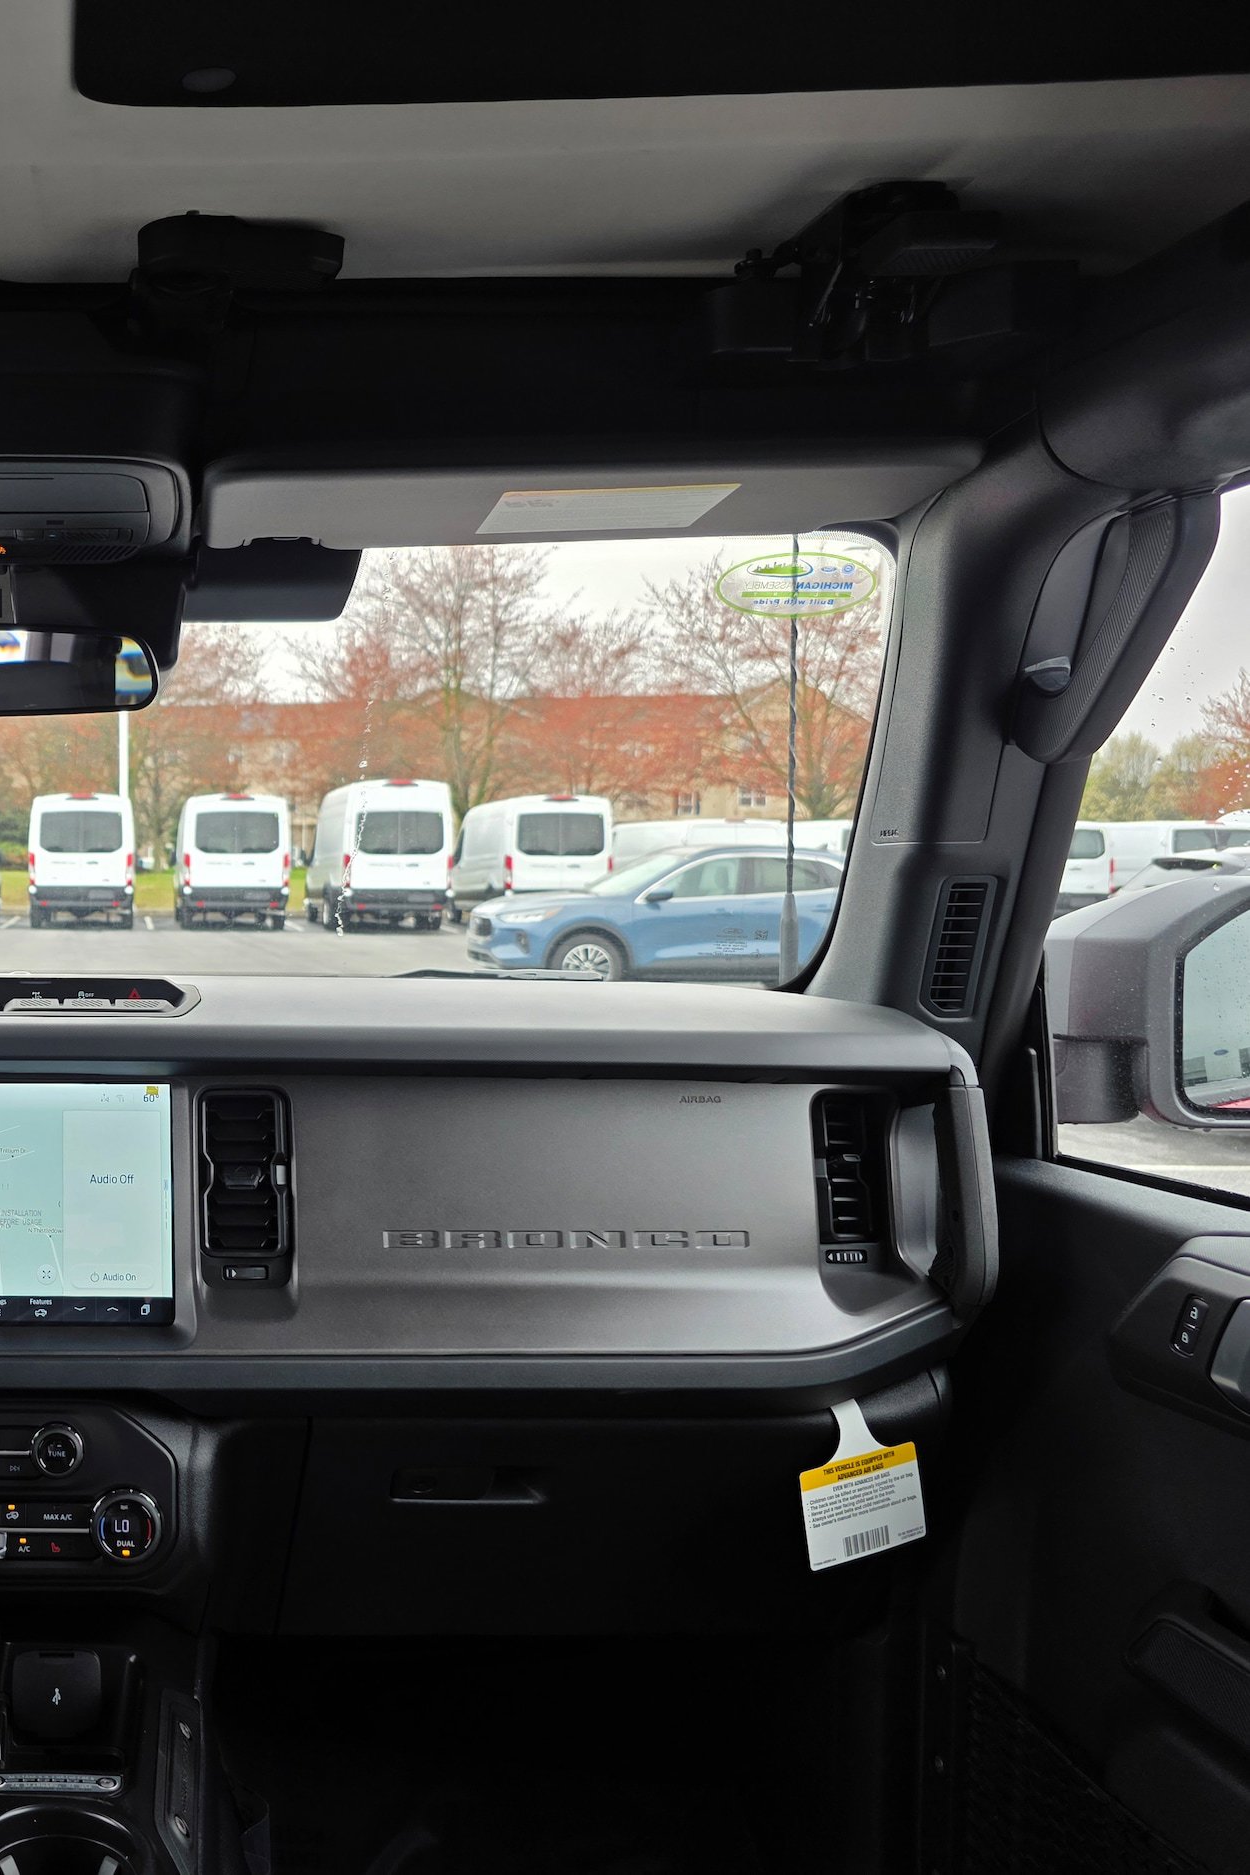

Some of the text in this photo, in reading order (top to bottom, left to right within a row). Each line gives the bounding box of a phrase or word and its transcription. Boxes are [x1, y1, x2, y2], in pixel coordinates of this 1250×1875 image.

[679, 1095, 722, 1104] AIRBAG
[89, 1174, 135, 1185] Audio Off
[0, 1209, 42, 1217] INSTALLATION
[382, 1229, 750, 1249] BRONCO
[103, 1273, 137, 1282] Audio On
[836, 1462, 854, 1472] VEHICLE
[862, 1455, 882, 1465] EQUIPPED
[838, 1469, 862, 1480] ADVANCED
[873, 1463, 884, 1471] BAGS
[60, 1513, 73, 1521] A/C
[114, 1519, 130, 1533] LO
[116, 1540, 136, 1548] DUAL
